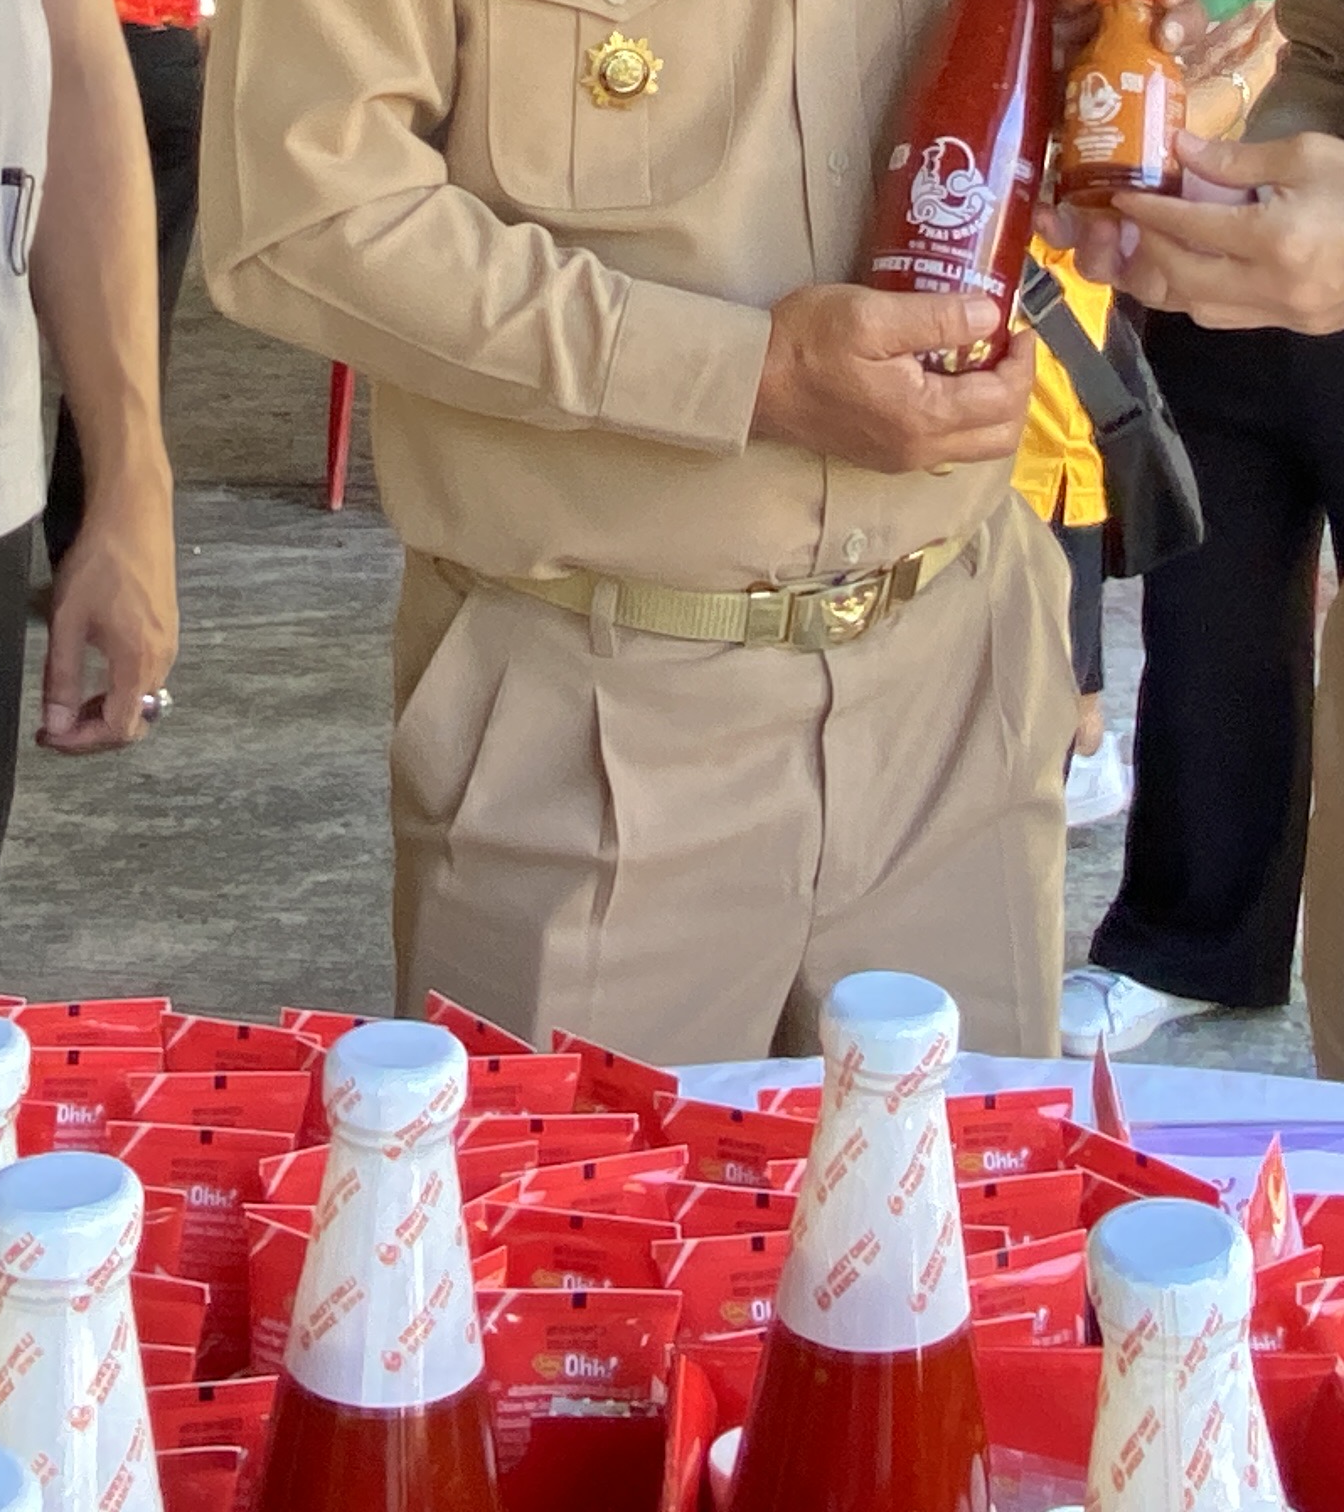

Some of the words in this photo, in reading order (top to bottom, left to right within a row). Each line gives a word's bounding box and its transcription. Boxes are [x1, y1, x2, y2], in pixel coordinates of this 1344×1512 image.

[913, 257, 963, 280] CHILLI
[982, 1148, 1030, 1171] Ohh!
[564, 1354, 619, 1378] Ohh!
